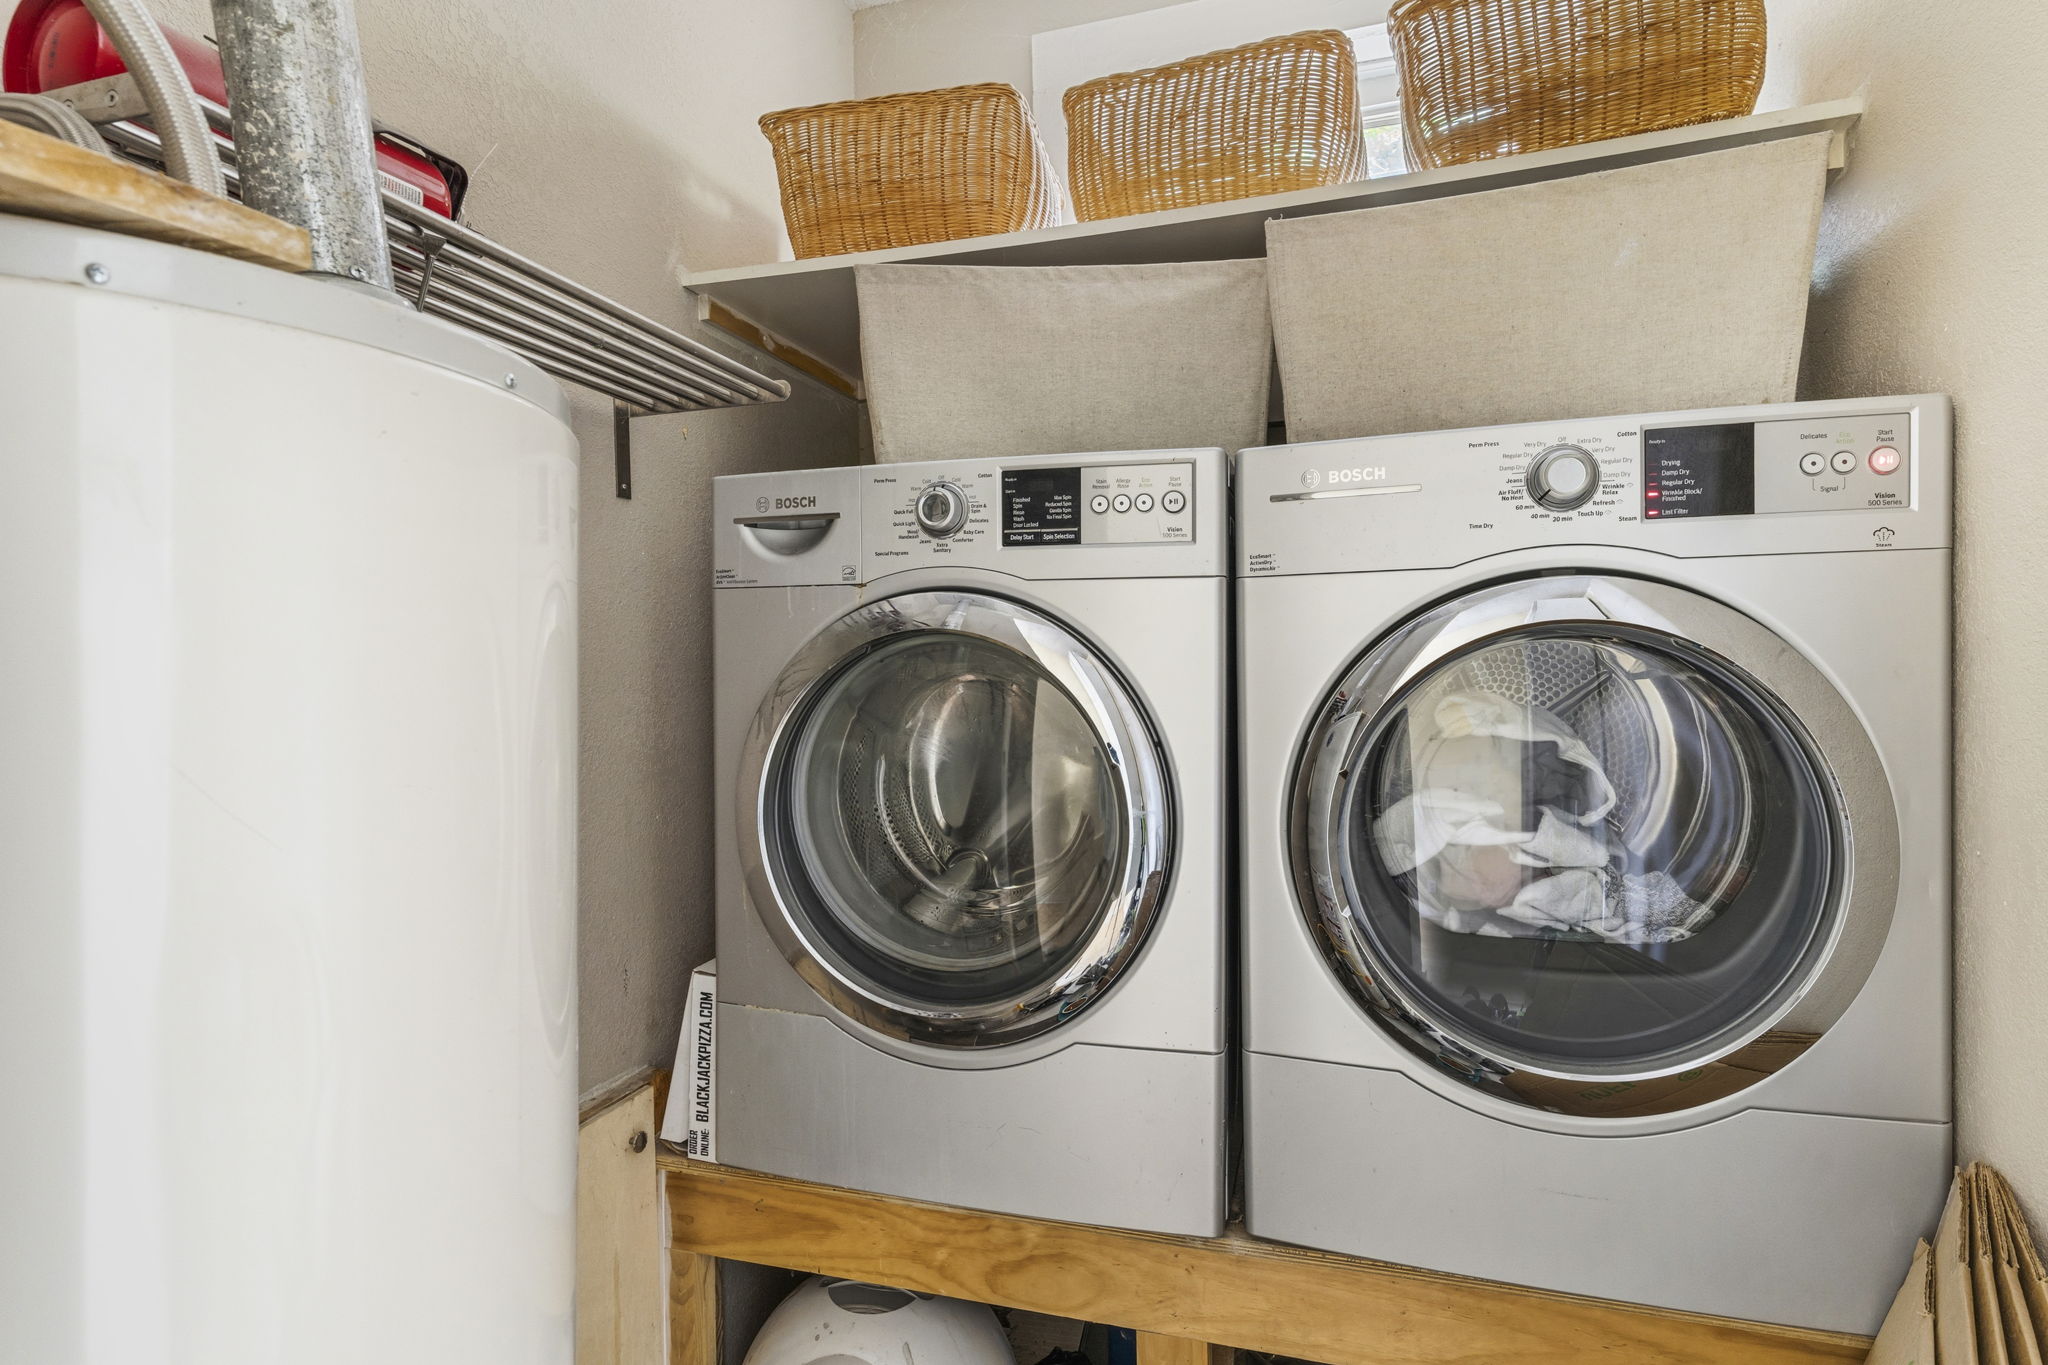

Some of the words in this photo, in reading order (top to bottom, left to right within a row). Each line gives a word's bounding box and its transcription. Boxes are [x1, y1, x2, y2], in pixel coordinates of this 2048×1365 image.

[1328, 467, 1386, 484] BOSCH
[776, 496, 816, 509] BOSCH
[696, 992, 713, 1123] BLACKJACKPIZZA.COM
[689, 1130, 698, 1155] ORDER
